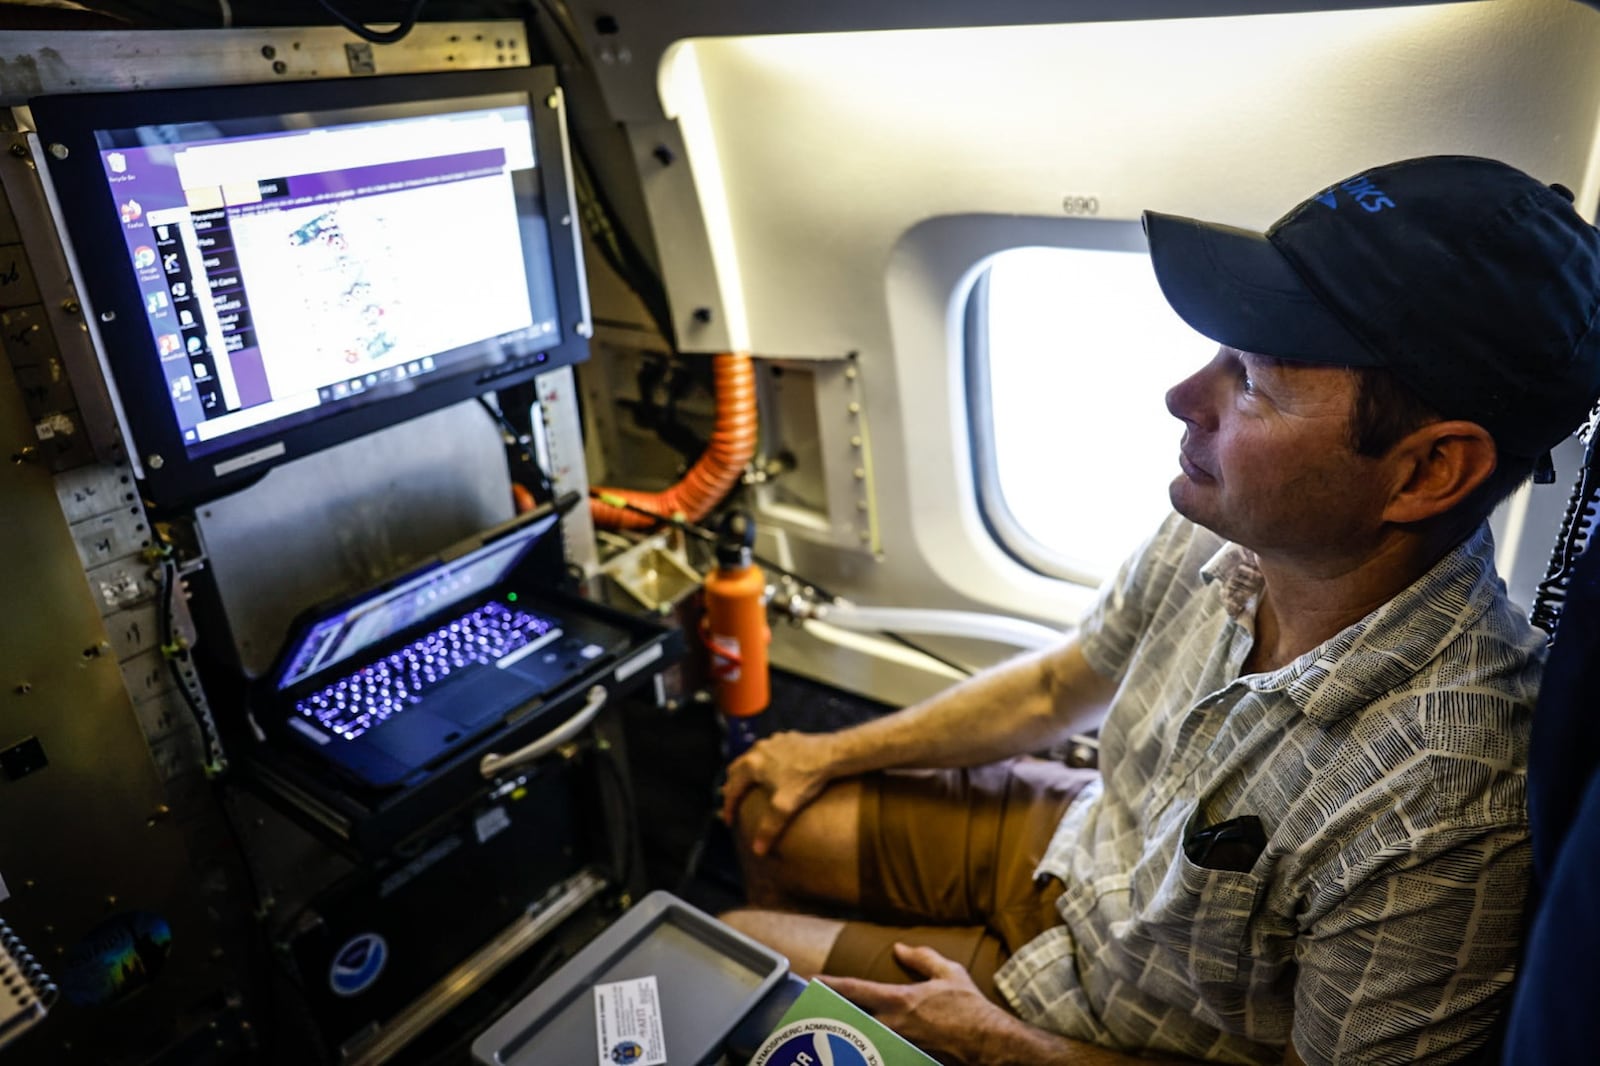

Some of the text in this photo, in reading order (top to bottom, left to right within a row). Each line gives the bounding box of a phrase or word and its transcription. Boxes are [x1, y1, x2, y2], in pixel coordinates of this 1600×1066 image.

[1062, 195, 1100, 216] 690
[755, 1026, 803, 1066] ATMOSPHERIC
[804, 1023, 867, 1051] ADMINISTRATION
